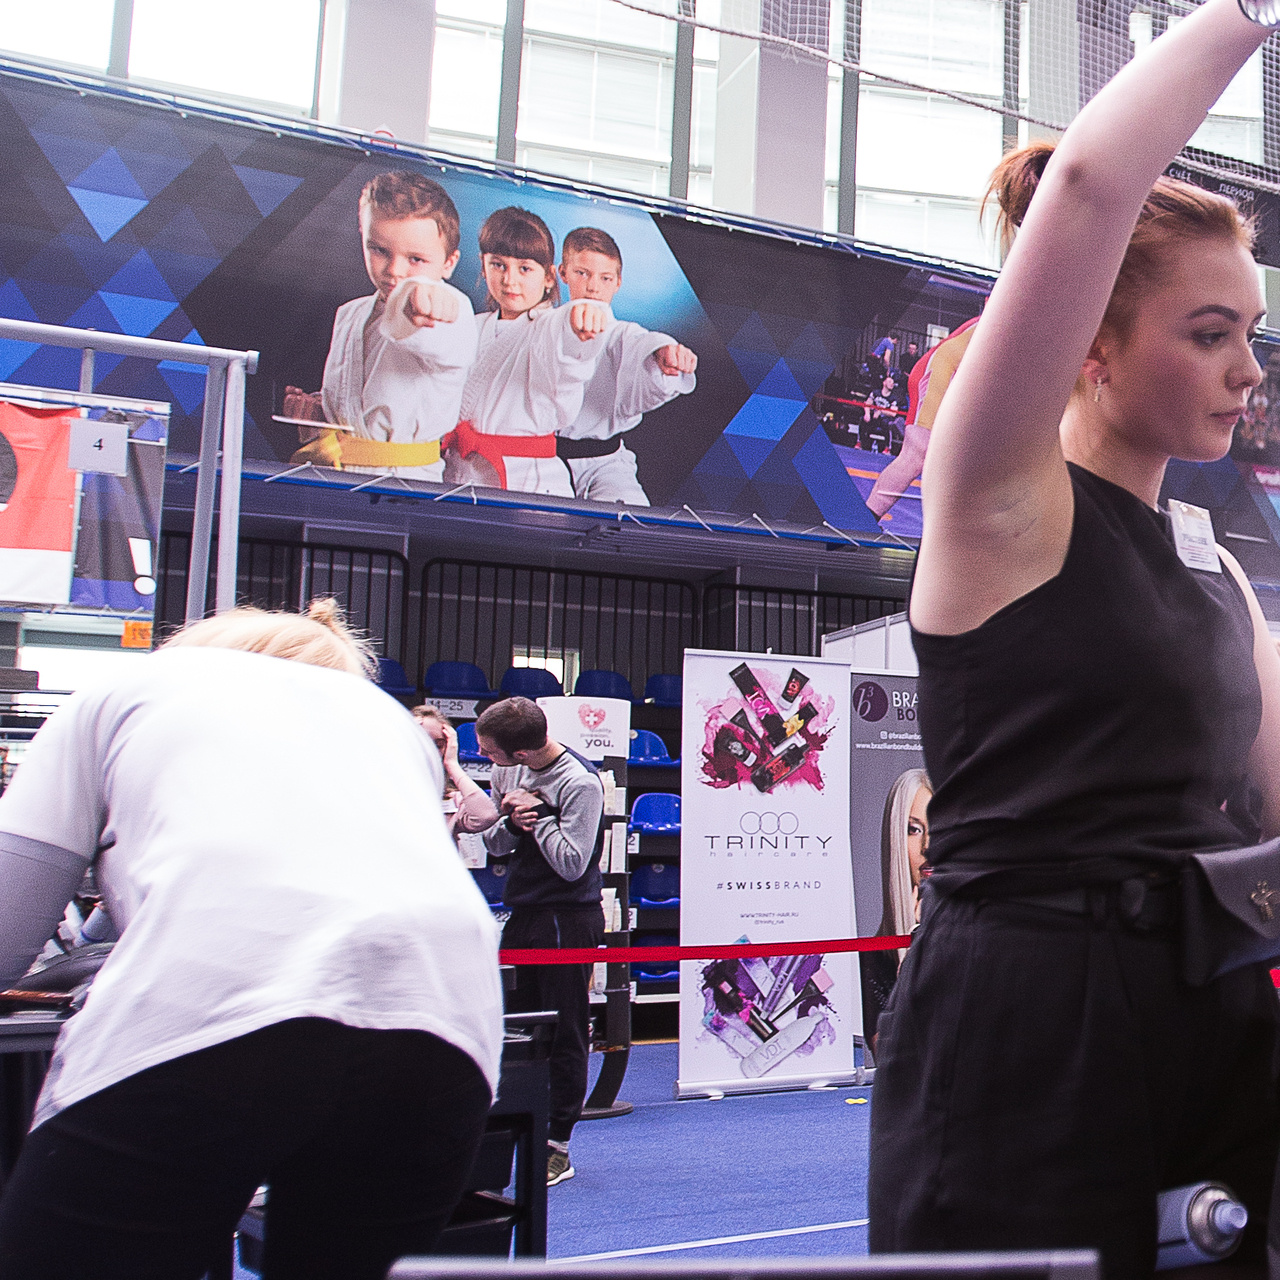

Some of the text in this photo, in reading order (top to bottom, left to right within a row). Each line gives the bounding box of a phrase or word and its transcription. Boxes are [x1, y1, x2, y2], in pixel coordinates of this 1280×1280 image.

[1219, 183, 1254, 200] ПЕРИОД
[93, 438, 103, 451] 4
[585, 738, 614, 748] you.
[704, 835, 832, 849] TRINITY
[716, 881, 822, 890] #SWISSBRAND
